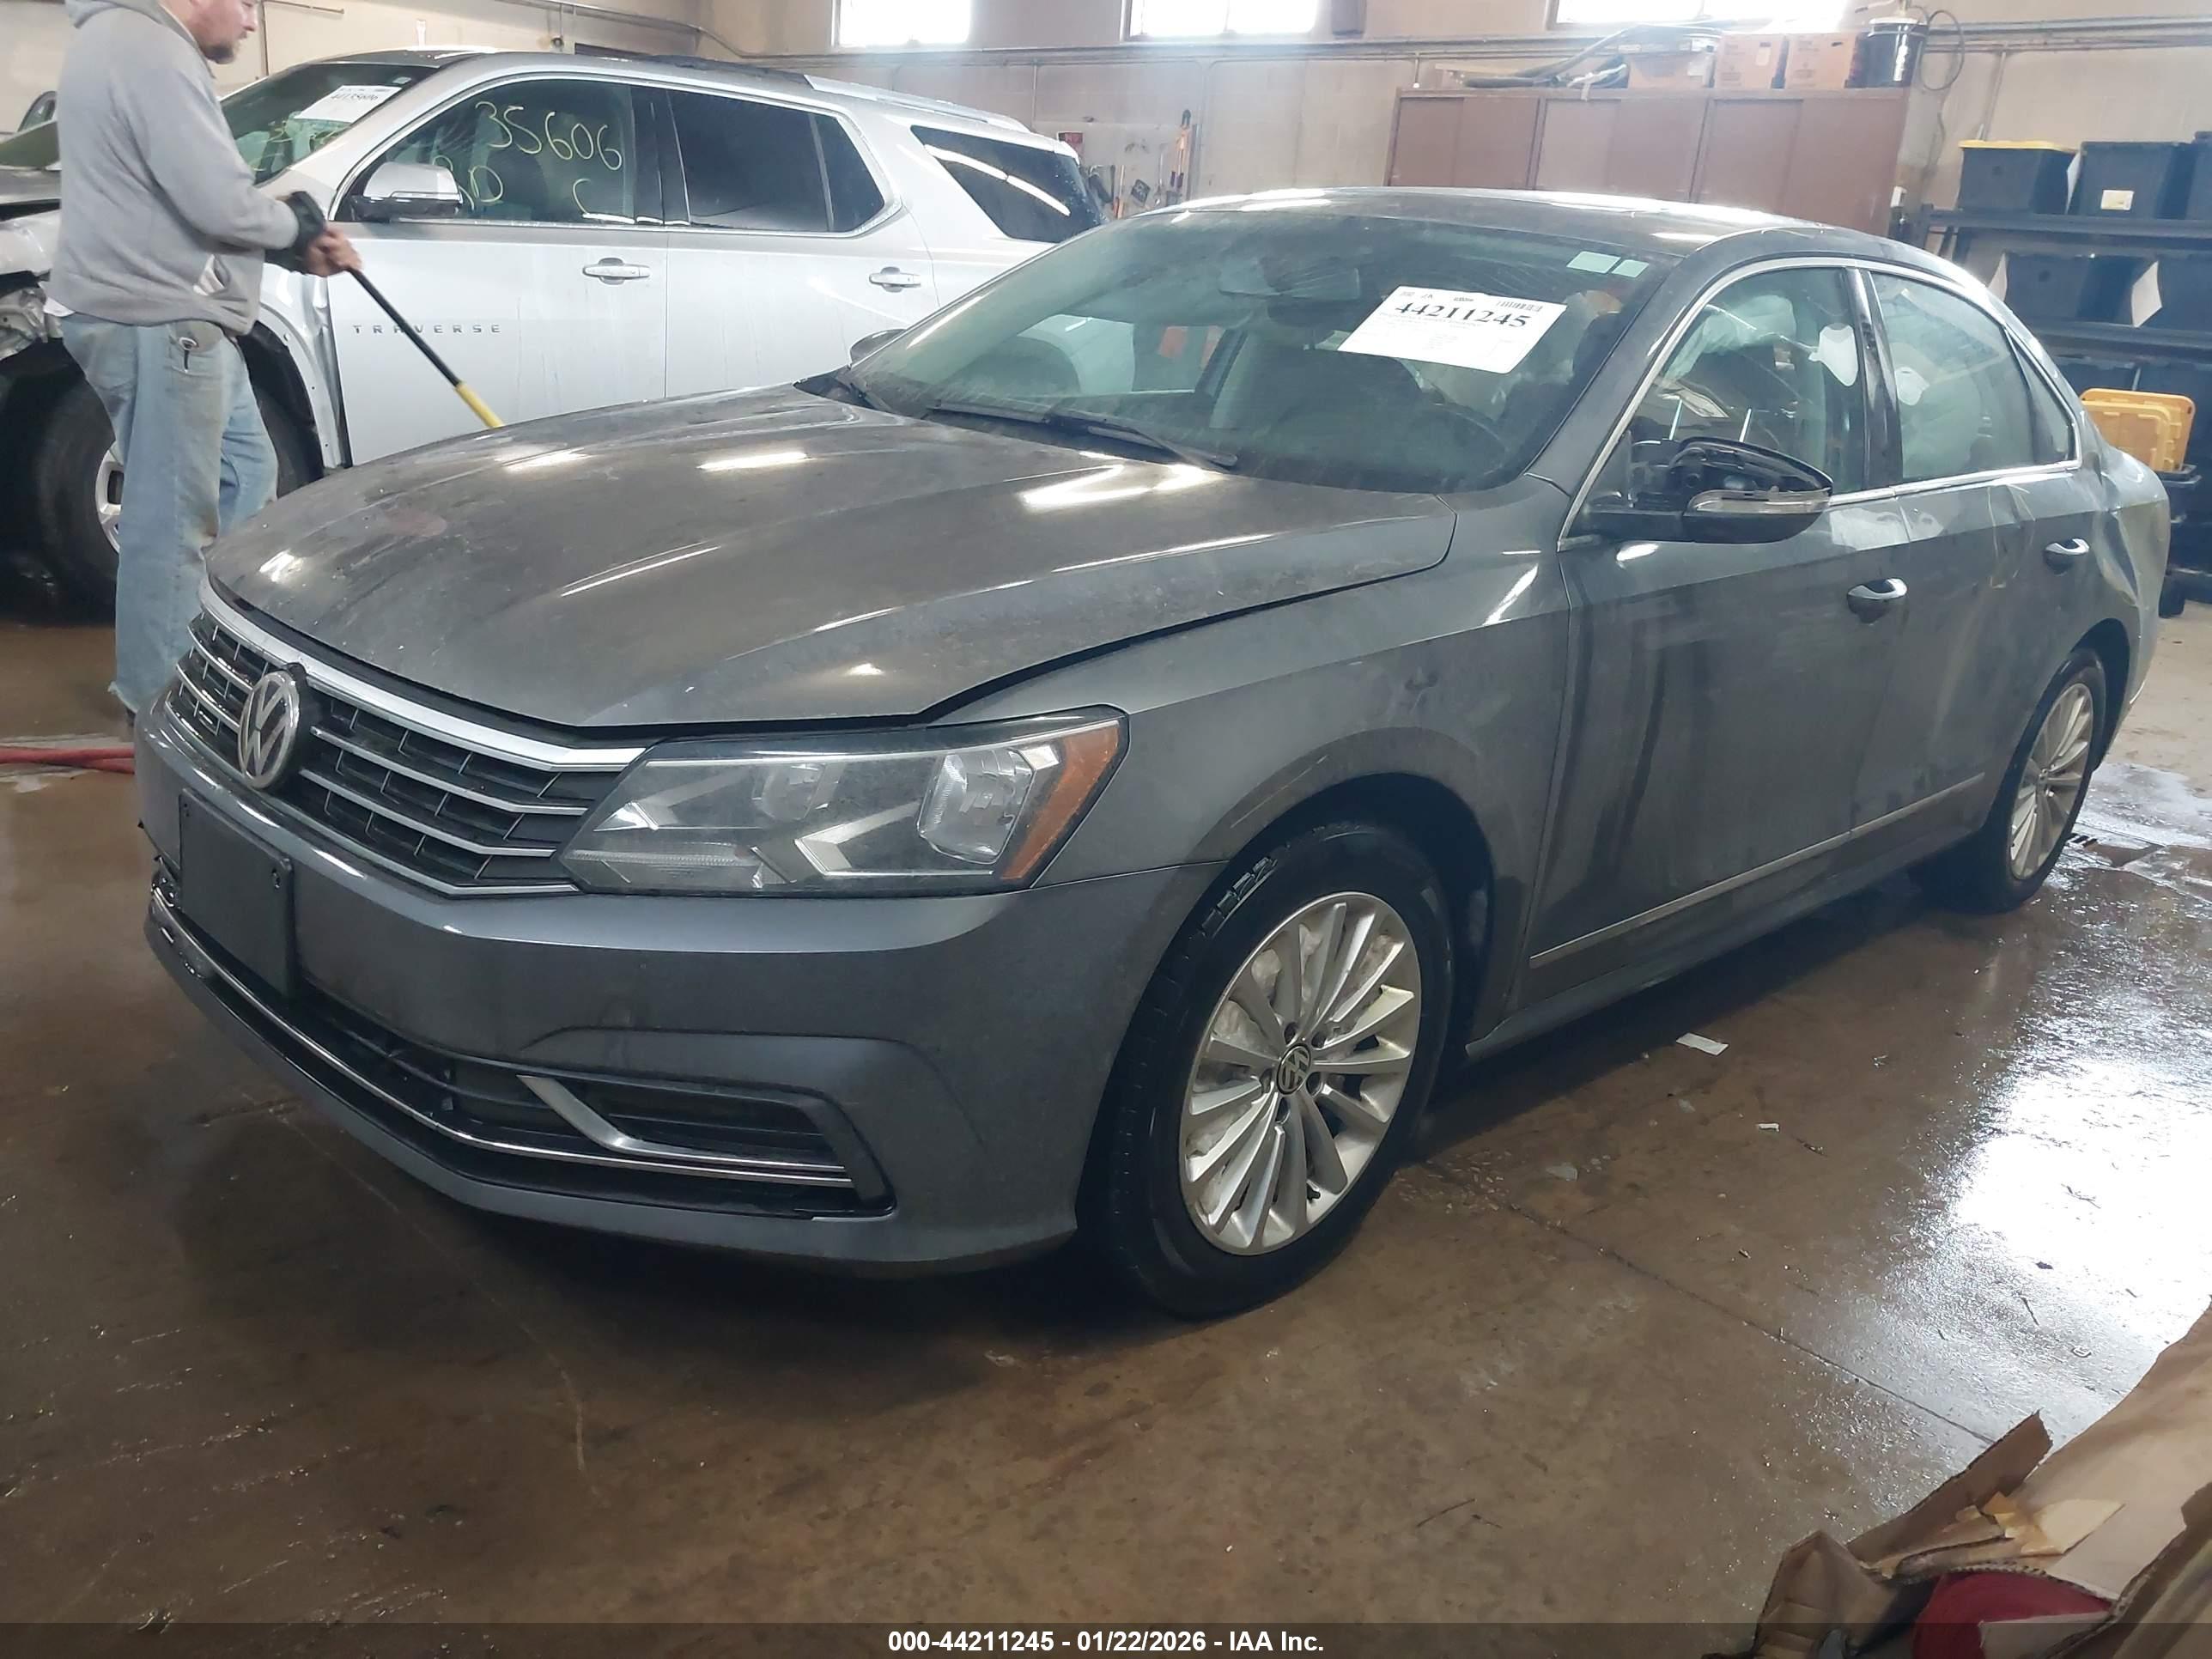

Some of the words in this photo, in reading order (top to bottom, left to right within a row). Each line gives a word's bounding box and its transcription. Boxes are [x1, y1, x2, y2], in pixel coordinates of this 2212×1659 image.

[475, 100, 623, 171] 35606
[1395, 301, 1532, 328] 44211245
[353, 324, 501, 334] TRAVERSE
